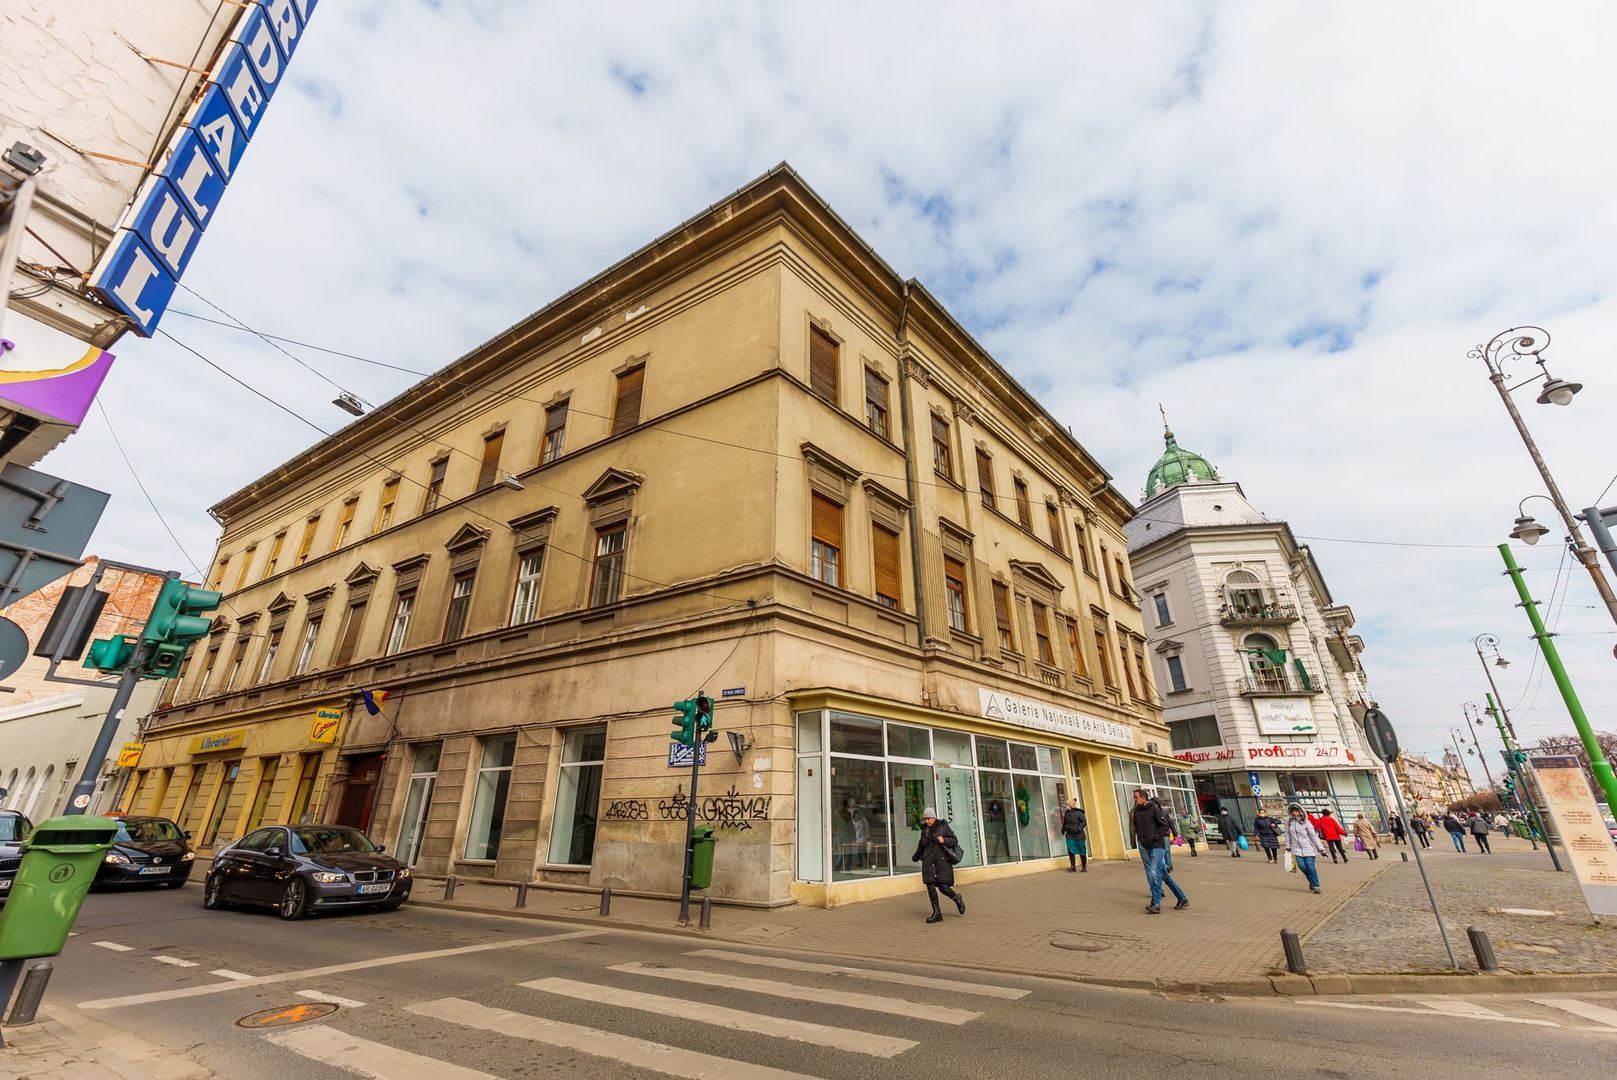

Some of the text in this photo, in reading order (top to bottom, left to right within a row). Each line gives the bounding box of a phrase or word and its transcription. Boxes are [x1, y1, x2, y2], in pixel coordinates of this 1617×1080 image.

[115, 0, 308, 327] RDEALUL
[1004, 697, 1039, 719] Galeria
[1083, 719, 1091, 731] de
[1248, 745, 1339, 760] profiCITY 24/7
[945, 776, 954, 824] VIZUALE
